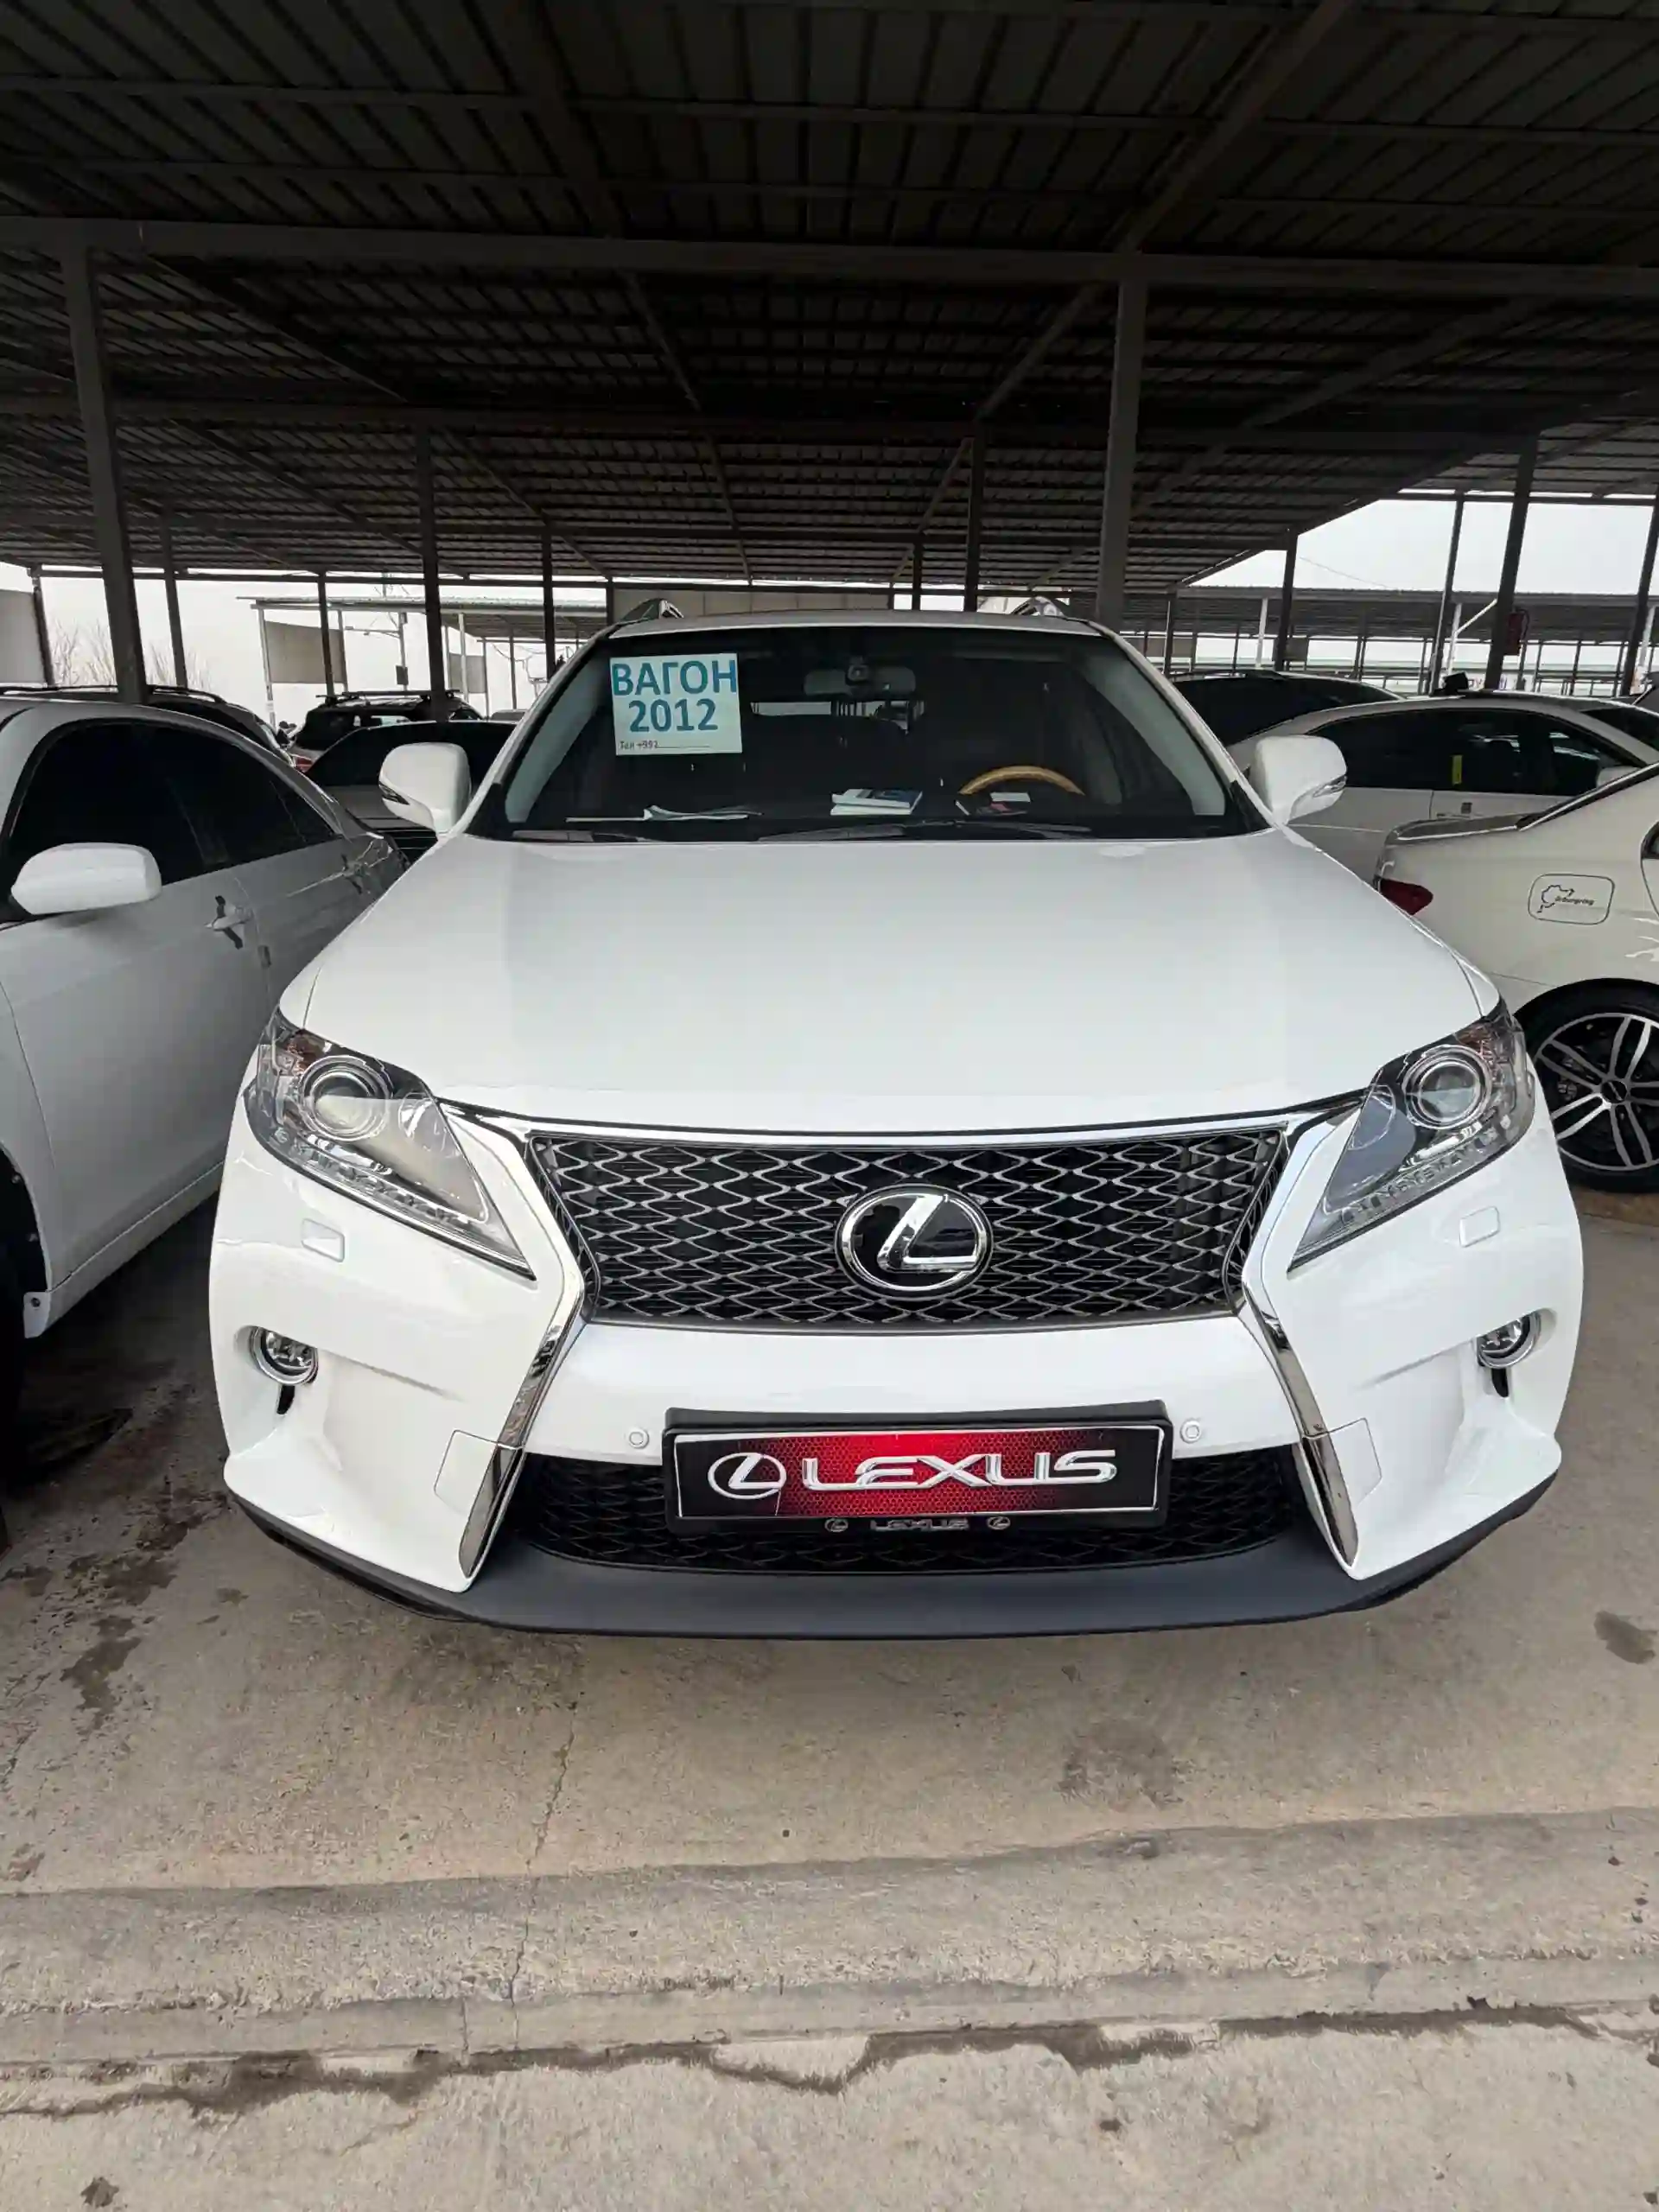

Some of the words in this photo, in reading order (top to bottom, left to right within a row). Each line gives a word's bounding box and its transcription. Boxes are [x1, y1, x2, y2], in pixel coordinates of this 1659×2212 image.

[611, 659, 737, 696] ВАГОН
[628, 698, 718, 733] 2012
[802, 1449, 1118, 1491] LEXUS
[869, 1517, 970, 1532] LEXUS
